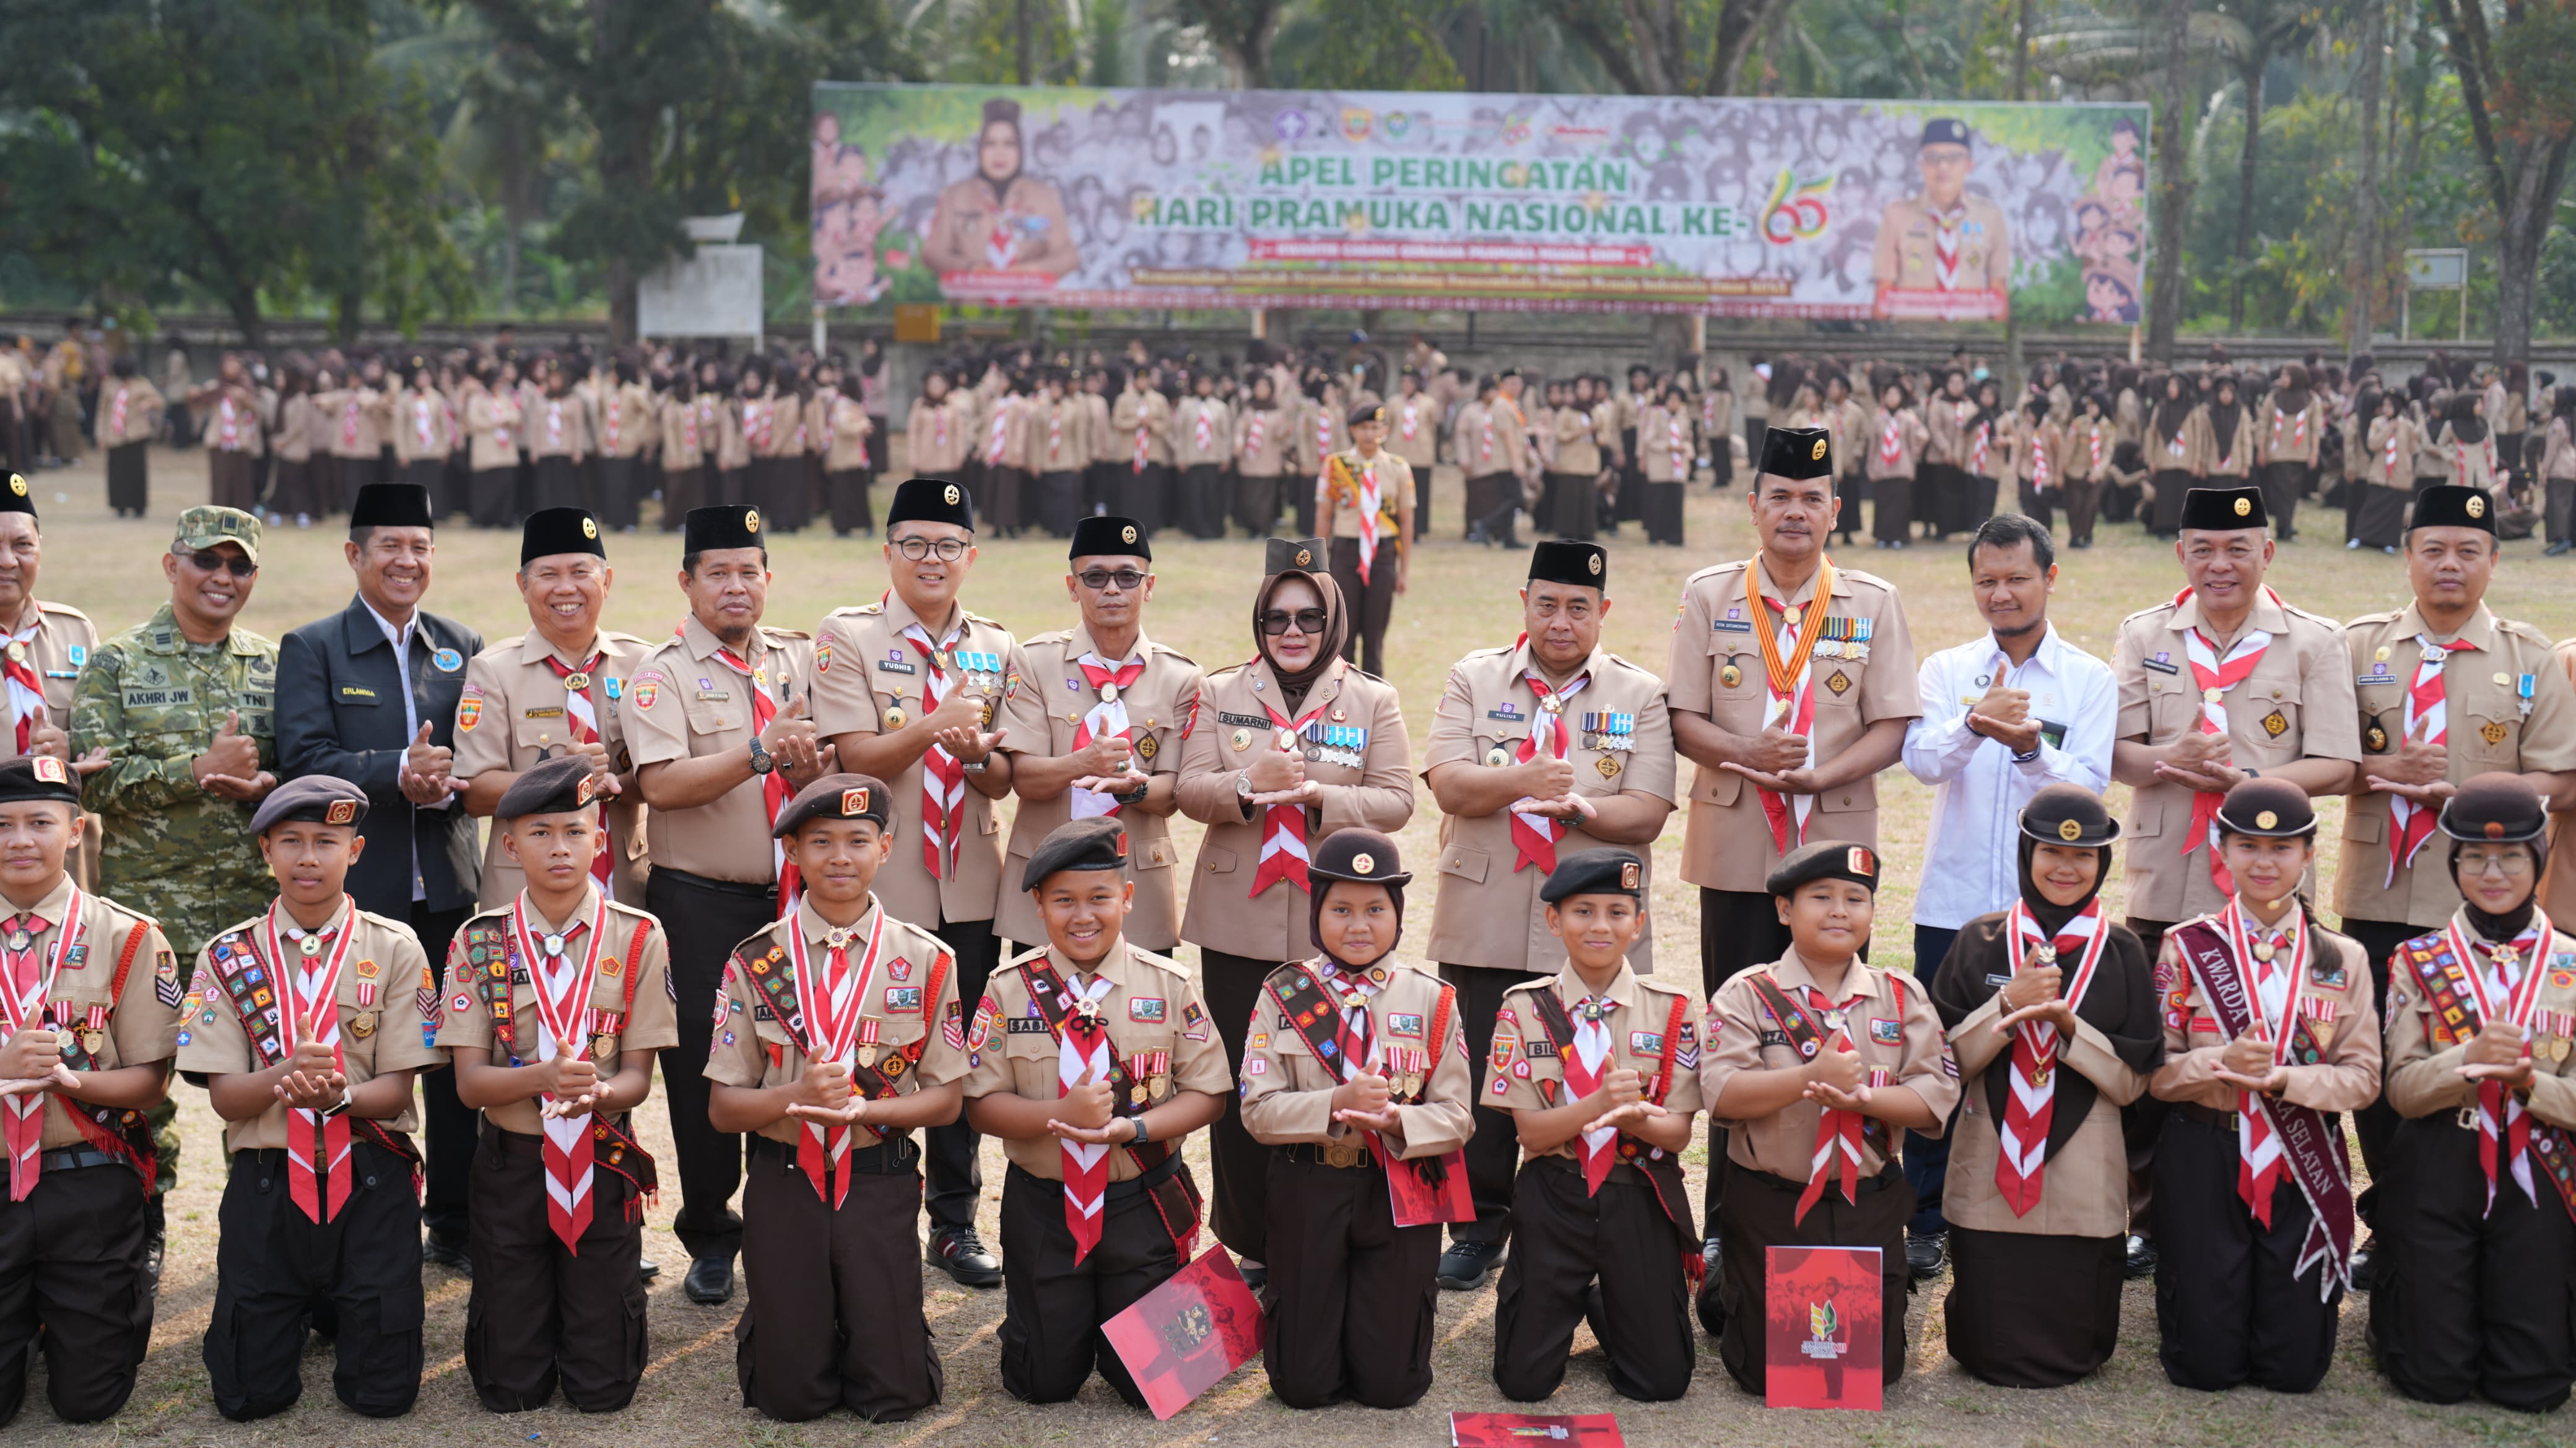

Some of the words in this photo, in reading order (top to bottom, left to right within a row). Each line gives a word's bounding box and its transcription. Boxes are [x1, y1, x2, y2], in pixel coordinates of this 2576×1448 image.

[1260, 157, 1355, 186] APEL
[1137, 194, 1234, 228] HARI
[1250, 197, 1450, 231] PRAMUKA
[1467, 201, 1666, 235] NASIONAL
[1681, 207, 1747, 236] KE-
[884, 661, 912, 672] YUDHIS
[128, 690, 167, 706] AKHRI
[169, 690, 189, 703] JW
[242, 693, 267, 707] TNI
[1222, 714, 1269, 729] SUMARNI
[1189, 1017, 1203, 1027] COBRA
[2198, 947, 2248, 1024] KWARDA
[2285, 1117, 2334, 1197] SELATAN
